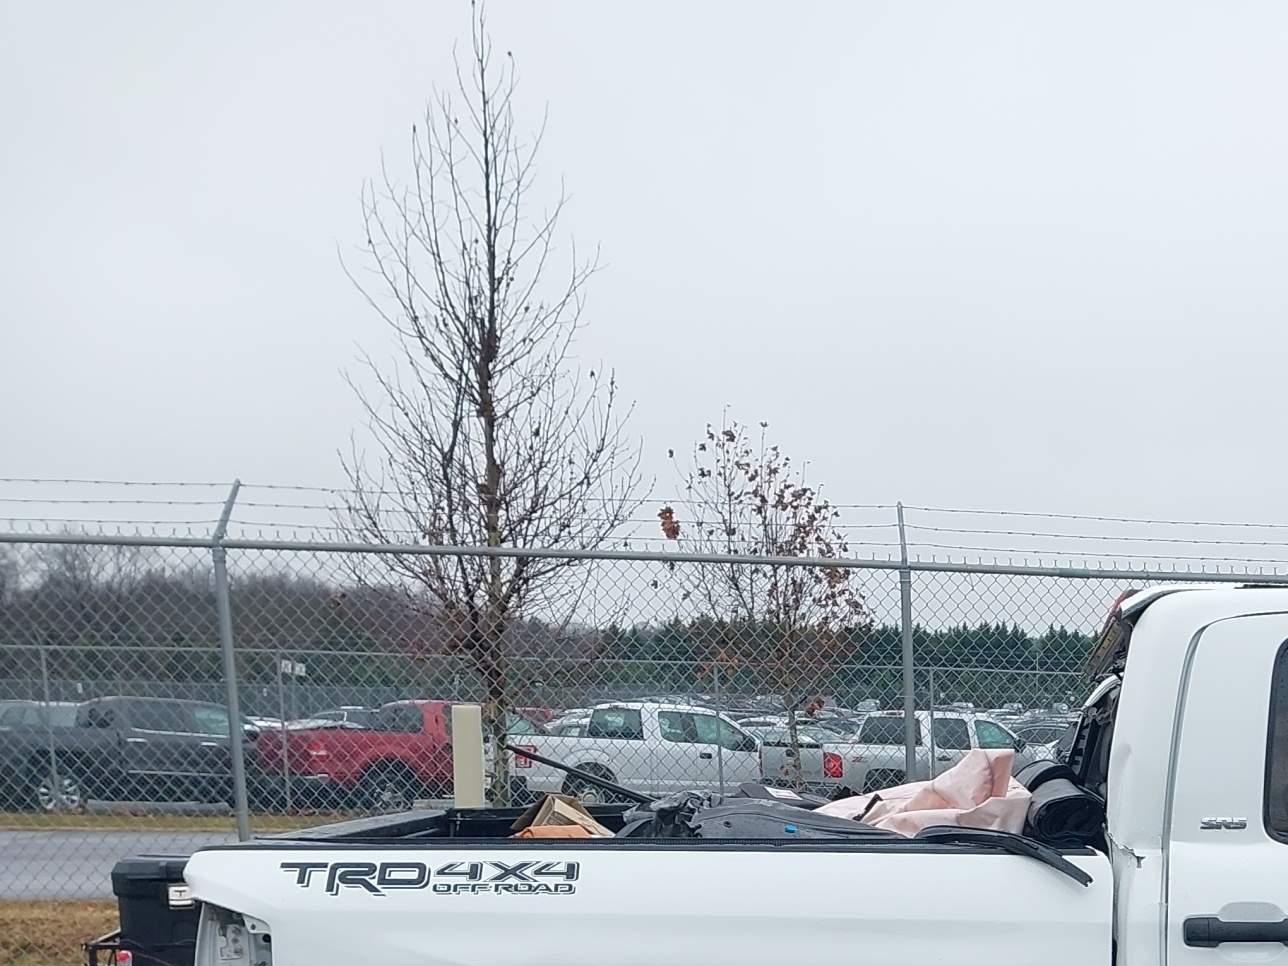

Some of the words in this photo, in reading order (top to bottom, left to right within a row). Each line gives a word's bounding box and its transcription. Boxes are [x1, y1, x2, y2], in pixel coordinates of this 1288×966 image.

[280, 862, 431, 897] TRD
[433, 861, 580, 882] 4X4
[432, 883, 492, 895] OFF
[493, 883, 576, 895] ROAD
